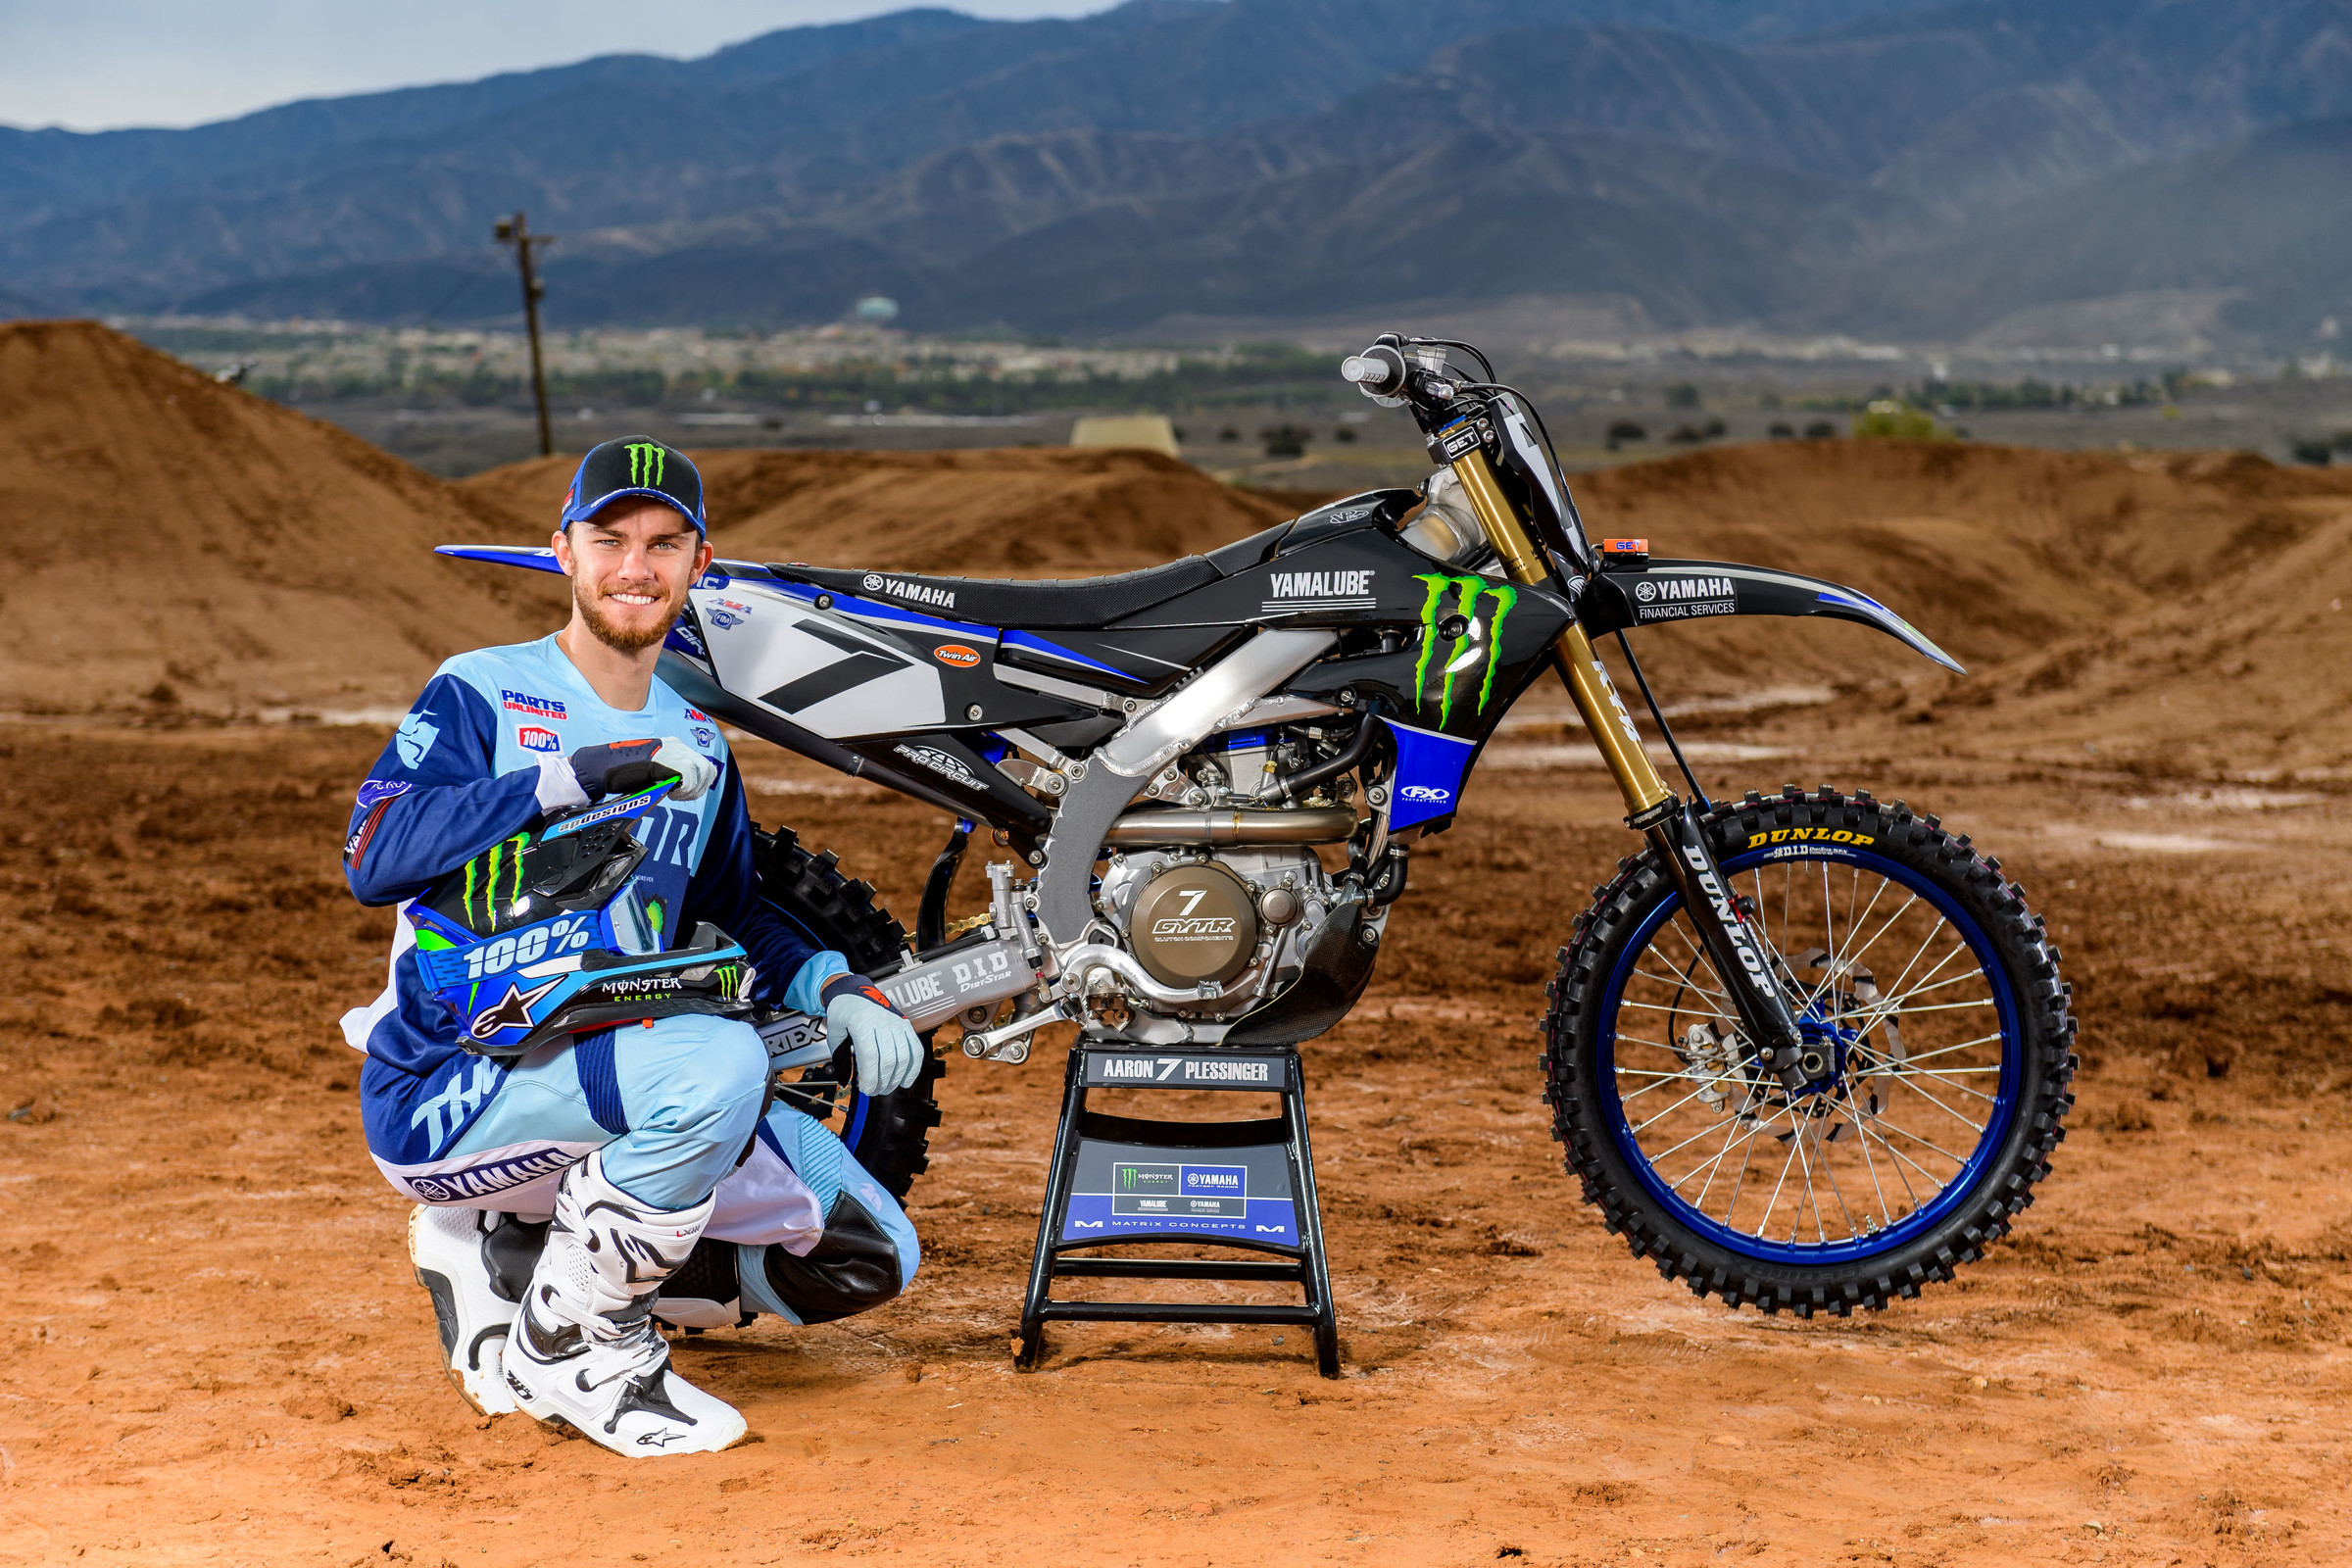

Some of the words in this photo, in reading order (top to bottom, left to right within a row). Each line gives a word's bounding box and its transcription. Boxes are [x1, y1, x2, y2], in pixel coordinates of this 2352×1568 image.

[1446, 431, 1474, 453] GET
[1616, 540, 1641, 551] GET
[885, 578, 956, 609] YAMAHA
[1270, 570, 1370, 597] YAMALUBE
[1657, 578, 1735, 600] YAMAHA
[706, 598, 753, 615] AMA
[1640, 606, 1689, 619] FINANCIAL
[1690, 603, 1735, 616] SERVICES
[716, 613, 730, 624] FIM
[758, 618, 914, 714] 7
[938, 650, 962, 661] Twin
[961, 654, 977, 663] Air
[501, 689, 565, 712] PARTS
[503, 701, 567, 720] UNLIMITED
[684, 708, 714, 724] AMA
[522, 730, 557, 750] 100%
[893, 744, 931, 765] PRO
[927, 760, 990, 791] CIRCUIT
[558, 795, 651, 832] apdesigns
[1747, 827, 1875, 850] DUNLOP
[1179, 890, 1207, 916] 7
[1152, 917, 1236, 934] GYTR
[1683, 845, 1776, 998] DUNLOP
[464, 915, 589, 980] 100%
[952, 951, 1008, 985] D.I.D
[613, 993, 671, 1002] ENERGY
[764, 1017, 826, 1058] RTEX
[1103, 1058, 1153, 1079] AARON
[1155, 1058, 1184, 1081] 7
[1185, 1061, 1269, 1082] PLESSINGER
[441, 1152, 577, 1198] YAMAHA
[1200, 1174, 1239, 1186] YAMAHA
[1140, 1200, 1167, 1208] YAMALUBE
